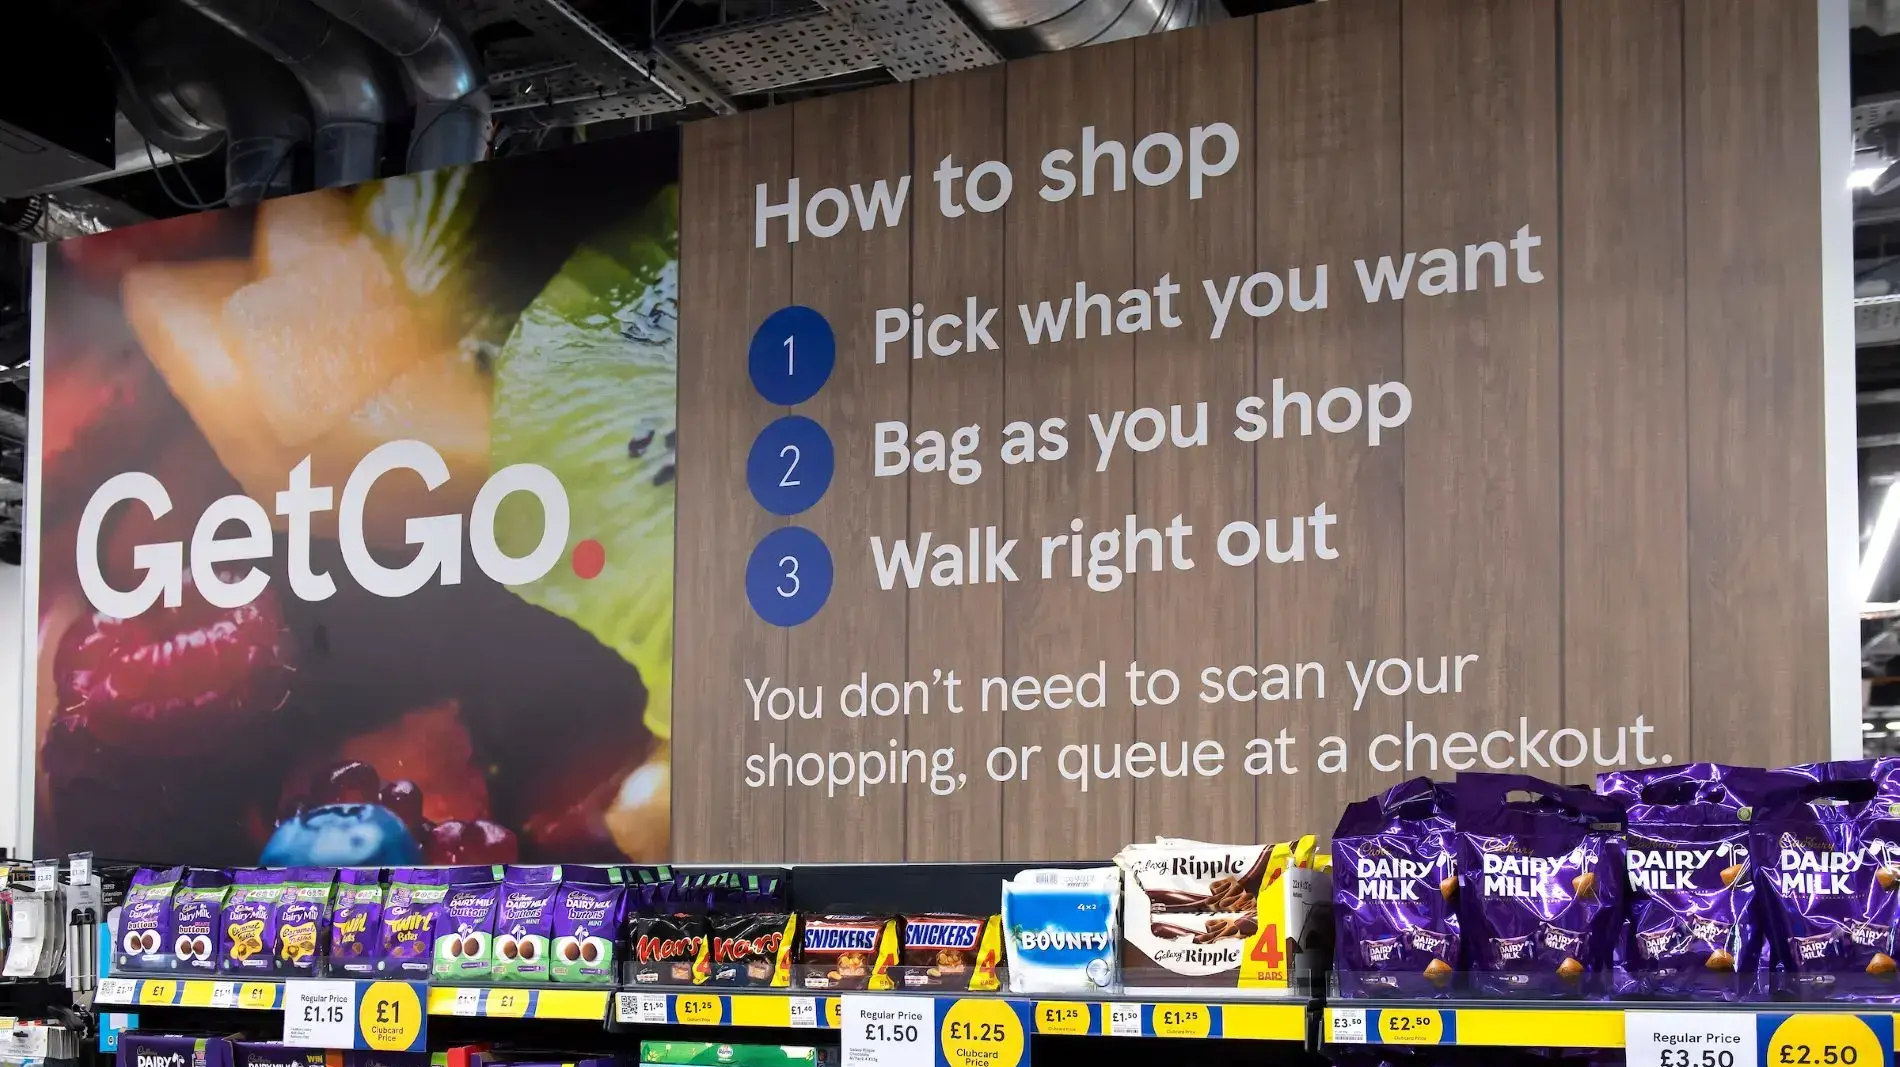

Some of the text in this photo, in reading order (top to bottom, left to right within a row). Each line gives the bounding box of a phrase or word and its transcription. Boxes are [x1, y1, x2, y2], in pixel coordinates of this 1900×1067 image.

[756, 123, 1239, 248] How to shop
[876, 224, 1544, 364] Pick what you want
[784, 336, 793, 375] 1
[875, 378, 1412, 485] Bag as you shop
[779, 445, 800, 486] 2
[869, 501, 1339, 592] Walk right out
[777, 556, 799, 597] 3
[744, 677, 822, 721] You
[982, 660, 1105, 712] need
[1125, 661, 1180, 706] to
[1199, 662, 1324, 703] scan
[1346, 654, 1479, 711] your
[745, 714, 1673, 797] shopping, or queue at a checkout.
[1172, 854, 1243, 879] Ripple
[1358, 858, 1435, 878] DAIRY
[1484, 853, 1565, 877] DAIRY
[1627, 850, 1715, 870] DAIRY
[1781, 848, 1865, 873] DAIRY
[1359, 880, 1420, 900] MILK
[1484, 876, 1552, 898] MILK
[1628, 869, 1698, 891] MILK
[1782, 873, 1855, 895] MILK
[282, 913, 302, 922] Dairy
[385, 912, 433, 933] Twirl
[568, 909, 604, 919] buttons
[127, 920, 159, 930] buttons
[179, 925, 210, 934] buttons
[805, 928, 876, 949] SNICKERS
[905, 924, 977, 947] SNICKERS
[1021, 930, 1108, 951] BOUNTY
[636, 934, 702, 965] Mars
[714, 932, 783, 965] Mars
[1250, 923, 1284, 969] 4
[1800, 941, 1828, 953] DAIRY
[979, 949, 996, 979] 4
[1154, 948, 1237, 966] Galaxy Ripple
[1258, 971, 1283, 981] BARS
[152, 986, 165, 996] £1
[252, 988, 263, 999] £1
[300, 994, 348, 1003] Regular Price
[501, 996, 513, 1006] £1
[304, 1006, 343, 1023] £1.15
[376, 1000, 399, 1023] £1
[643, 1002, 664, 1011] £1.50
[685, 1001, 712, 1013] £1.25
[791, 1005, 813, 1015] £1.40
[860, 1010, 923, 1021] Regular Price
[1046, 1009, 1078, 1023] £1.25
[1113, 1012, 1138, 1022] £1.50
[1164, 1012, 1198, 1025] £1.25
[1334, 1018, 1362, 1028] £3.50
[1389, 1017, 1431, 1031] £2.50
[371, 1026, 404, 1035] Clubcard
[378, 1034, 396, 1042] Price
[865, 1023, 918, 1042] £1.50
[950, 1022, 1006, 1042] £1.25
[1653, 1032, 1741, 1045] Regular Price
[956, 1048, 999, 1059] Clubcard
[965, 1058, 989, 1067] Price
[1660, 1049, 1735, 1067] £3.50
[1780, 1045, 1858, 1065] £2.50
